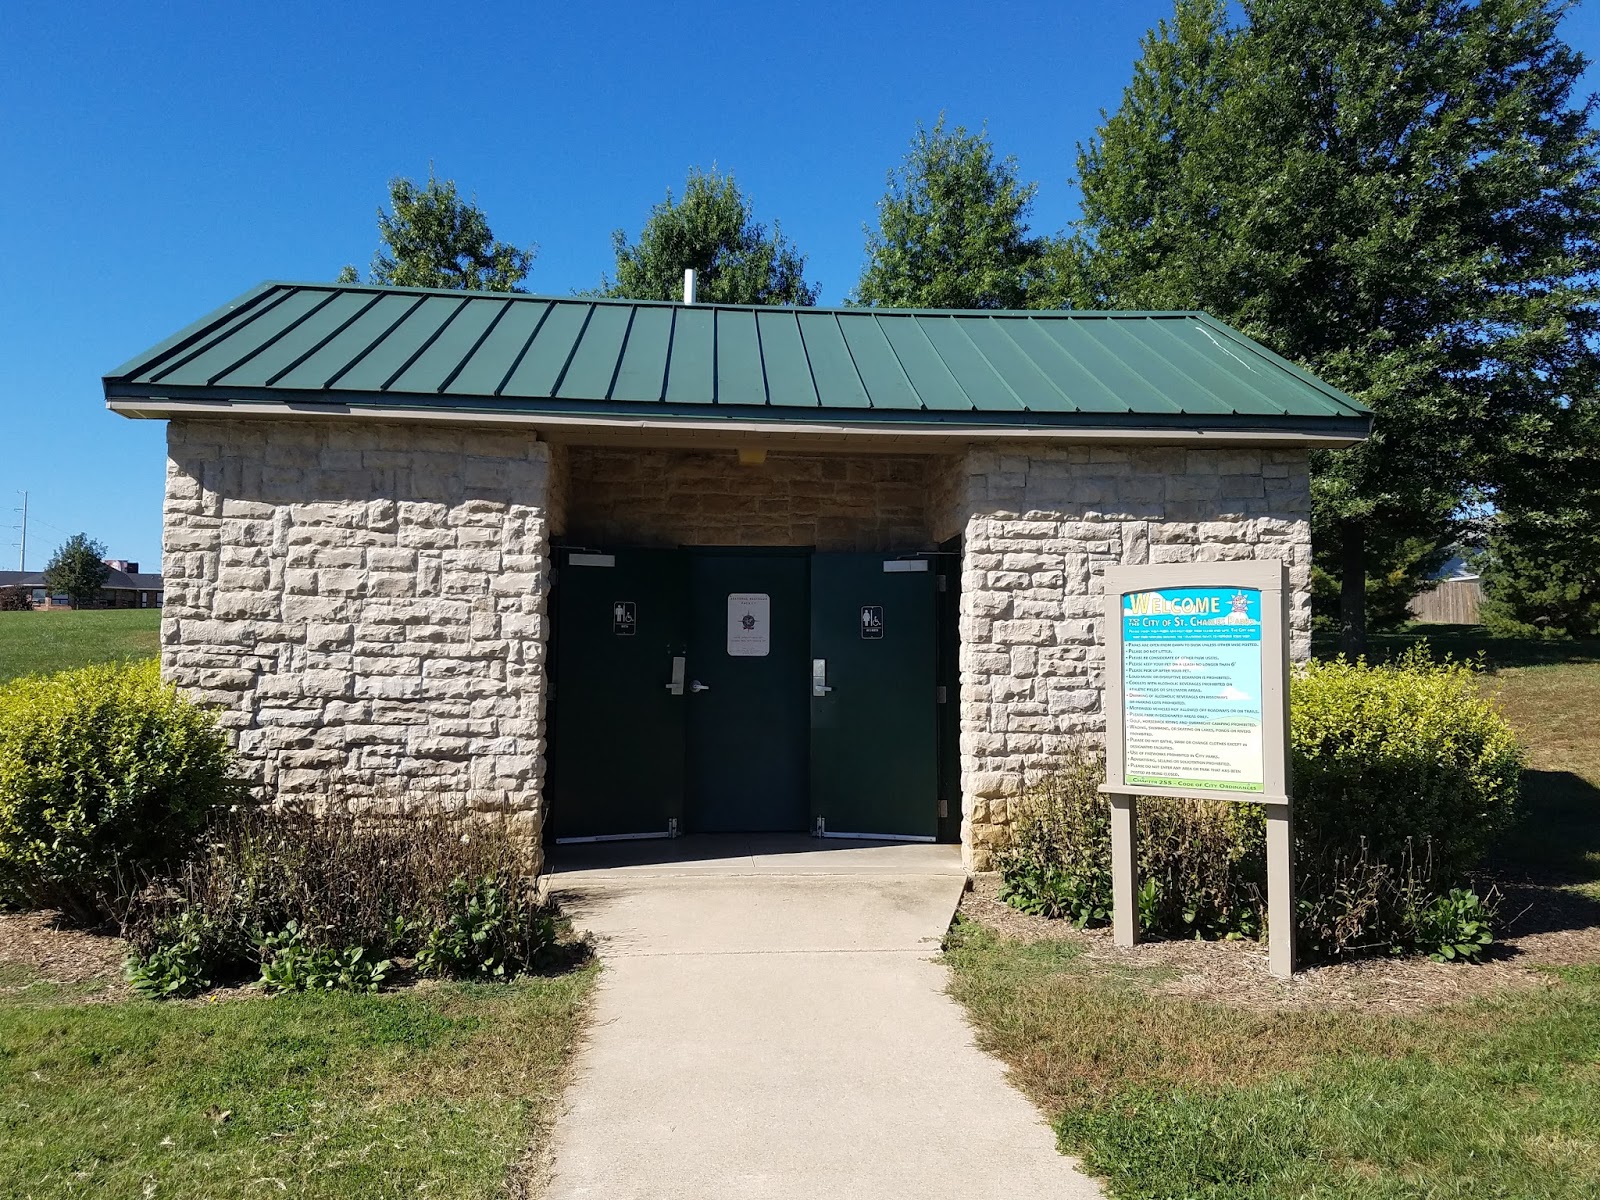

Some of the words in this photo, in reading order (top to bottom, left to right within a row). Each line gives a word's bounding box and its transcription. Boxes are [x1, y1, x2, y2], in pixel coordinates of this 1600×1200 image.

[1129, 592, 1220, 614] WELCOME
[1142, 617, 1159, 627] CITY
[1162, 619, 1172, 627] OF
[1174, 616, 1188, 627] ST.
[1189, 616, 1225, 626] CHARLES
[1219, 783, 1257, 791] ORDINANCES
